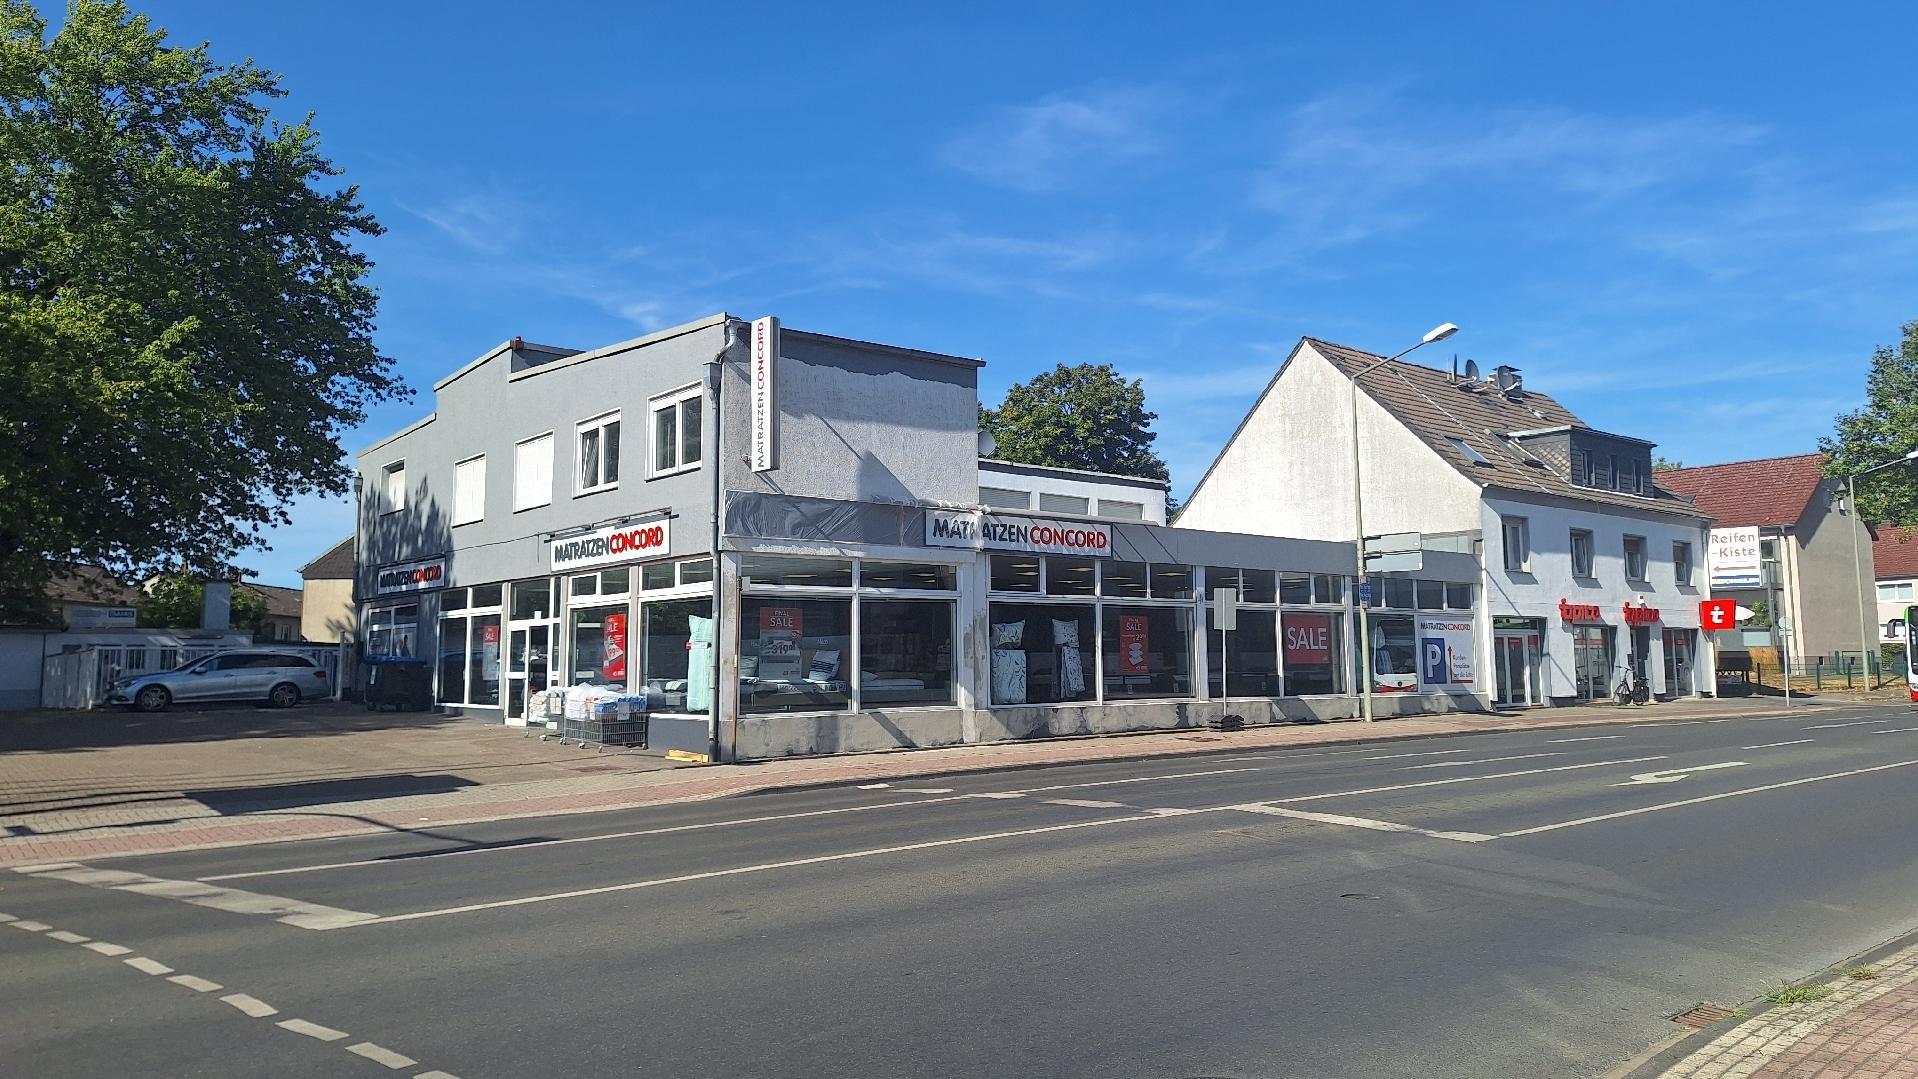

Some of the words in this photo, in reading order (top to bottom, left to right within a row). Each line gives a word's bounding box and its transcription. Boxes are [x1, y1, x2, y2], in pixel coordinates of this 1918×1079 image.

[757, 322, 765, 390] CONCORD
[554, 535, 609, 563] MATRATZEN
[609, 526, 664, 555] CONCORD
[1029, 525, 1107, 549] CONCORD
[1711, 532, 1755, 544] Reifen
[769, 617, 793, 627] SALE
[1126, 622, 1142, 631] SALE
[1287, 626, 1328, 650] SALE
[1426, 643, 1442, 678] P
